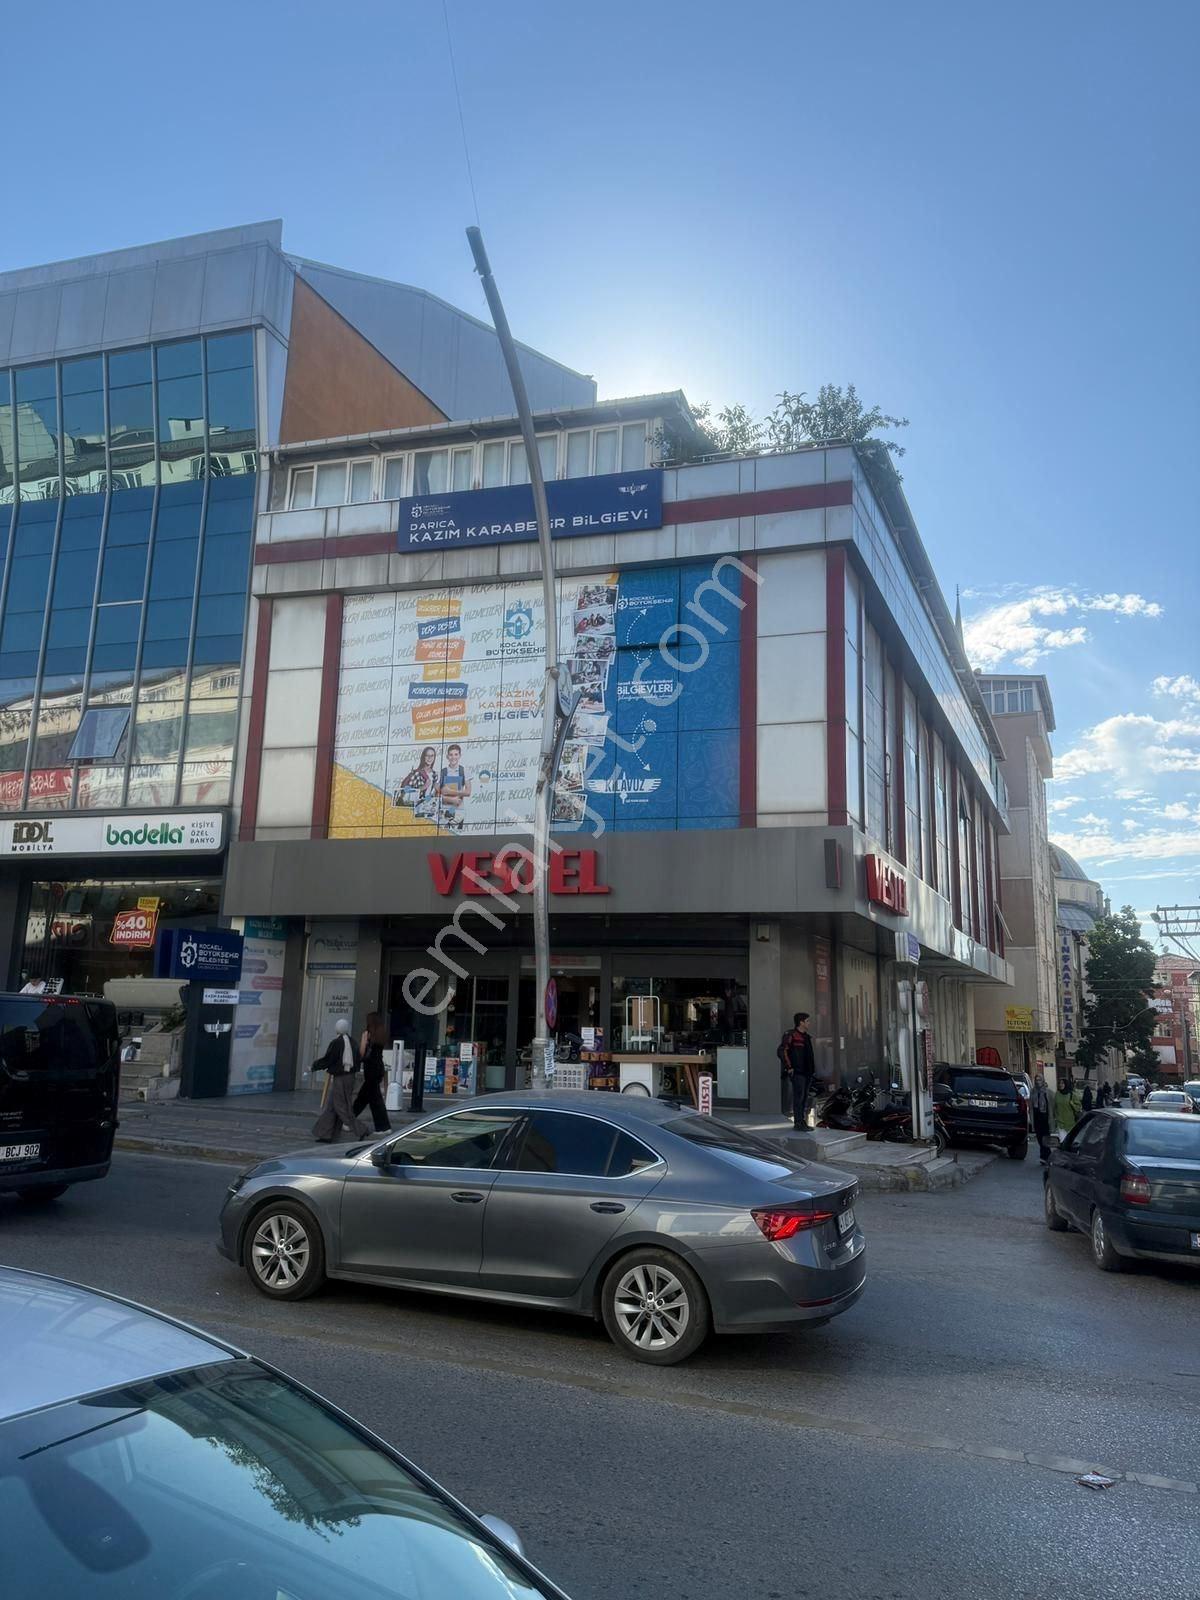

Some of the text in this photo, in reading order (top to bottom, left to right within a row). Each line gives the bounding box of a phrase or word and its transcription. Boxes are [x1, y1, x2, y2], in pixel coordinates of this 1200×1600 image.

[106, 822, 186, 847] badella
[5, 1144, 41, 1158] BCJ 902
